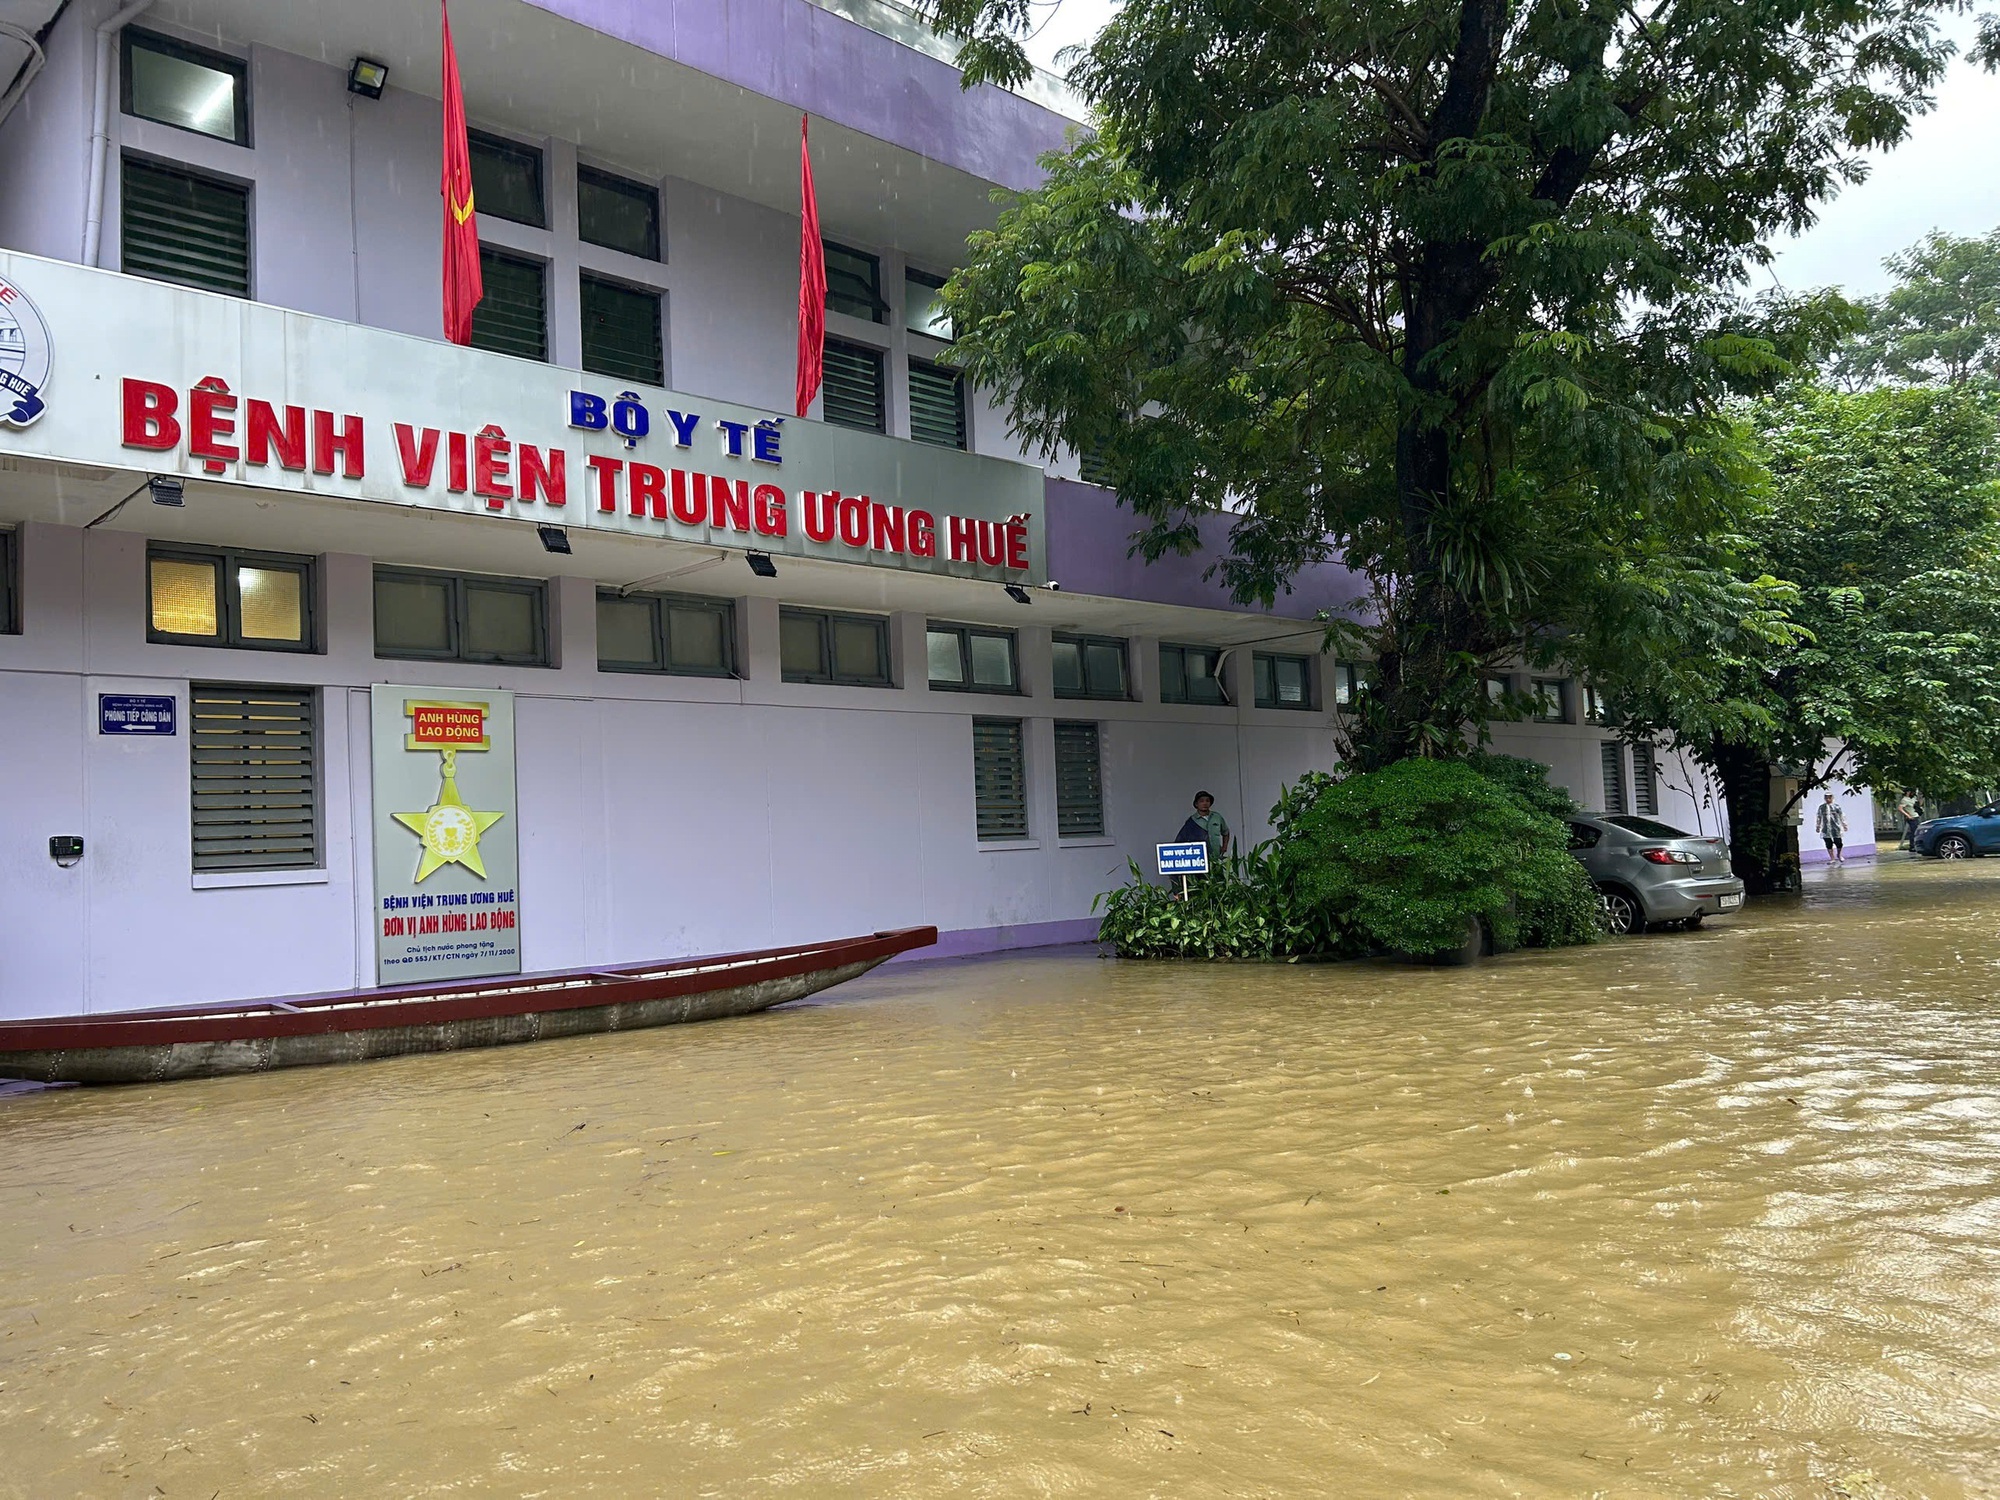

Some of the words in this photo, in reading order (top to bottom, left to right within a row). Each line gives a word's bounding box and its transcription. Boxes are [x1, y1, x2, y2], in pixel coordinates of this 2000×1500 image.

[567, 389, 650, 449] BỘ
[665, 409, 700, 448] Y
[716, 417, 785, 464] TẾ
[120, 375, 365, 480] BỆNH
[391, 423, 567, 510] VIỆN
[586, 454, 788, 538] TRUNG
[801, 489, 936, 558] ƯƠNG
[945, 513, 1032, 570] HUẾ
[104, 707, 126, 722] PHÒNG
[126, 707, 140, 722] TIẾP
[140, 708, 158, 722] CÔNG
[158, 709, 171, 723] DÂN
[418, 713, 443, 723] ANH
[446, 711, 480, 724] HÙNG
[419, 726, 443, 736] LAO
[446, 724, 480, 740] ĐỘNG
[1174, 857, 1191, 868] GIÁM
[383, 895, 409, 911] BỆNH
[412, 893, 434, 909] VIỆN
[436, 893, 468, 906] TRUNG
[470, 891, 495, 904] ƯƠNG
[383, 915, 404, 937] ĐƠN
[407, 916, 417, 938] VỊ
[419, 915, 439, 934] ANH
[442, 910, 467, 933] HÙNG
[470, 912, 488, 931] LAO
[490, 907, 515, 932] ĐỘNG
[456, 942, 478, 950] phong
[461, 950, 478, 960] ngày
